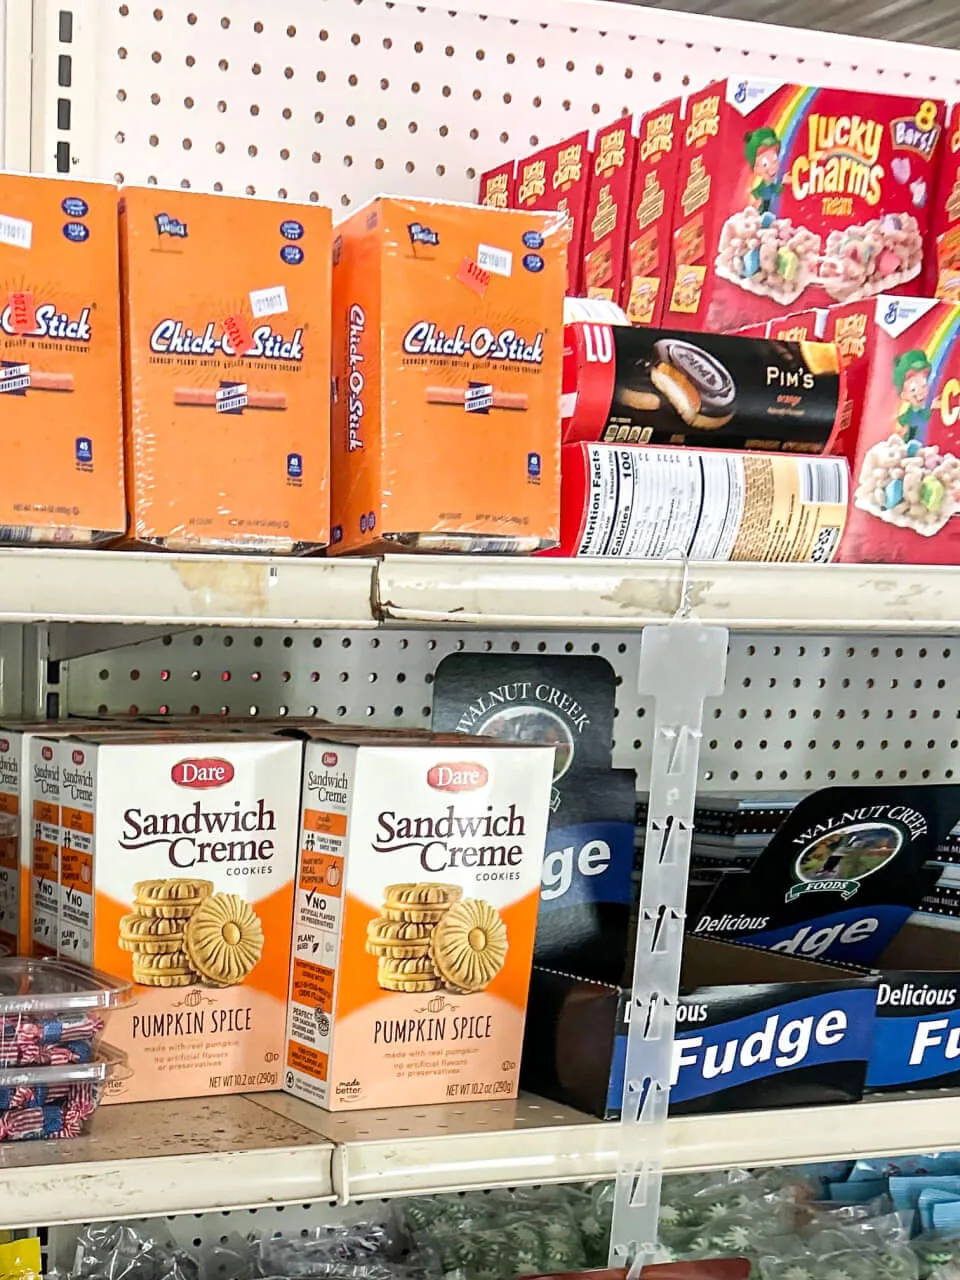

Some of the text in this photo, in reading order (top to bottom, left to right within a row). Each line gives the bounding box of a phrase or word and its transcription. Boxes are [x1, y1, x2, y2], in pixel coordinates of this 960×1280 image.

[403, 322, 544, 364] Chick-O-Stick
[583, 323, 612, 364] LU
[349, 303, 365, 452] Chick-O-Stick
[580, 450, 602, 556] Nutrition Facts
[456, 682, 591, 734] WALNUT CREEK
[180, 762, 226, 784] Dare
[308, 770, 348, 790] Sandwich
[434, 767, 481, 787] Dare
[317, 787, 347, 803] Creme
[122, 799, 276, 841] Sandwich
[375, 804, 527, 844] Sandwich
[793, 804, 932, 847] WALNUT CREEK
[169, 836, 275, 869] Creme
[420, 841, 522, 870] Creme
[225, 865, 273, 876] COOKIES
[475, 871, 521, 882] COOKIES
[804, 880, 848, 893] FOODS
[694, 913, 771, 934] Delicious
[877, 983, 957, 1007] Delicious
[132, 1007, 253, 1040] PUMPKIN SPICE
[373, 1015, 493, 1044] PUMPKIN SPICE
[669, 1009, 849, 1087] Fudge
[209, 1076, 221, 1089] NET
[446, 1084, 458, 1096] NET
